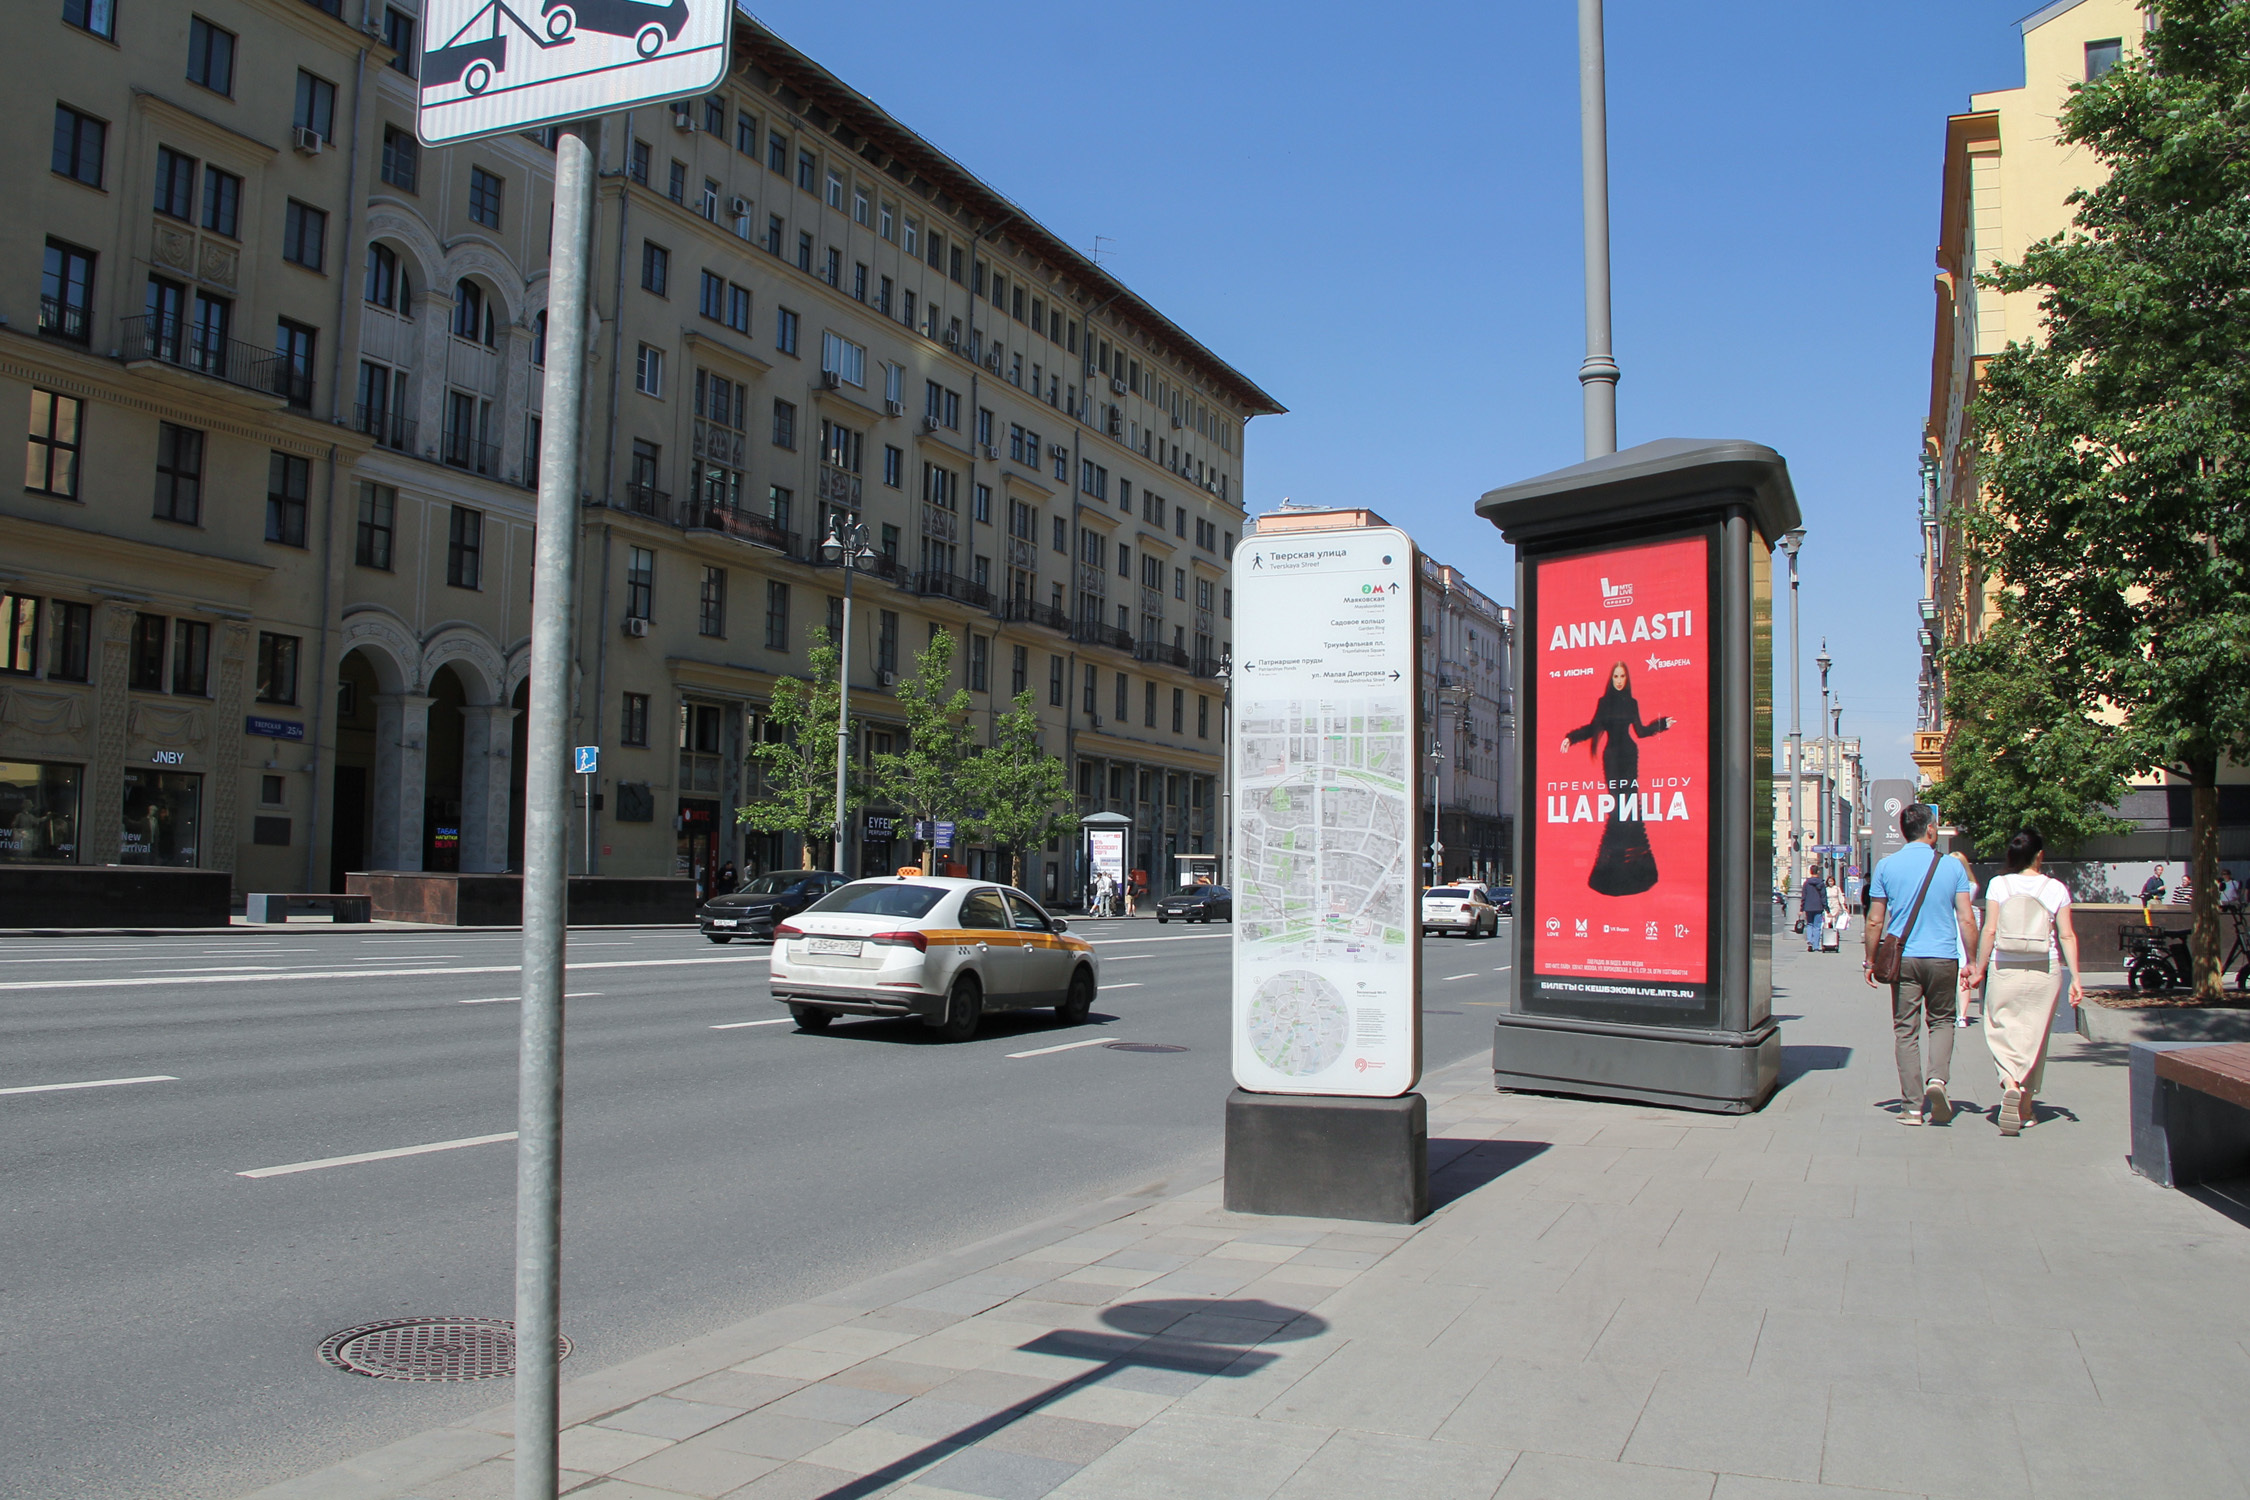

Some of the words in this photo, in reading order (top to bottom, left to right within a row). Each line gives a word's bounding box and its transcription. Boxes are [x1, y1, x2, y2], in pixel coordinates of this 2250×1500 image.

[1270, 552, 1314, 561] Тверская
[1317, 549, 1347, 559] улица
[1270, 562, 1300, 570] Tverskaya
[1550, 618, 1627, 651] ANNA
[1630, 610, 1692, 642] ASTI
[1324, 641, 1374, 649] Триумфальная
[1564, 668, 1594, 677] ИЮНЯ
[152, 751, 184, 764] JNBY
[1548, 778, 1640, 791] ПРЕМЬЕРА
[1652, 776, 1691, 788] ШОУ
[1547, 791, 1689, 824] ЦАРИЦА
[868, 816, 892, 830] EYFEL
[1674, 924, 1690, 938] 12+
[1540, 982, 1578, 991] БИЛЕТЫ
[1585, 984, 1636, 995] КЕШБЭКОМ
[1636, 988, 1694, 998] LIVE.MTS.RU
